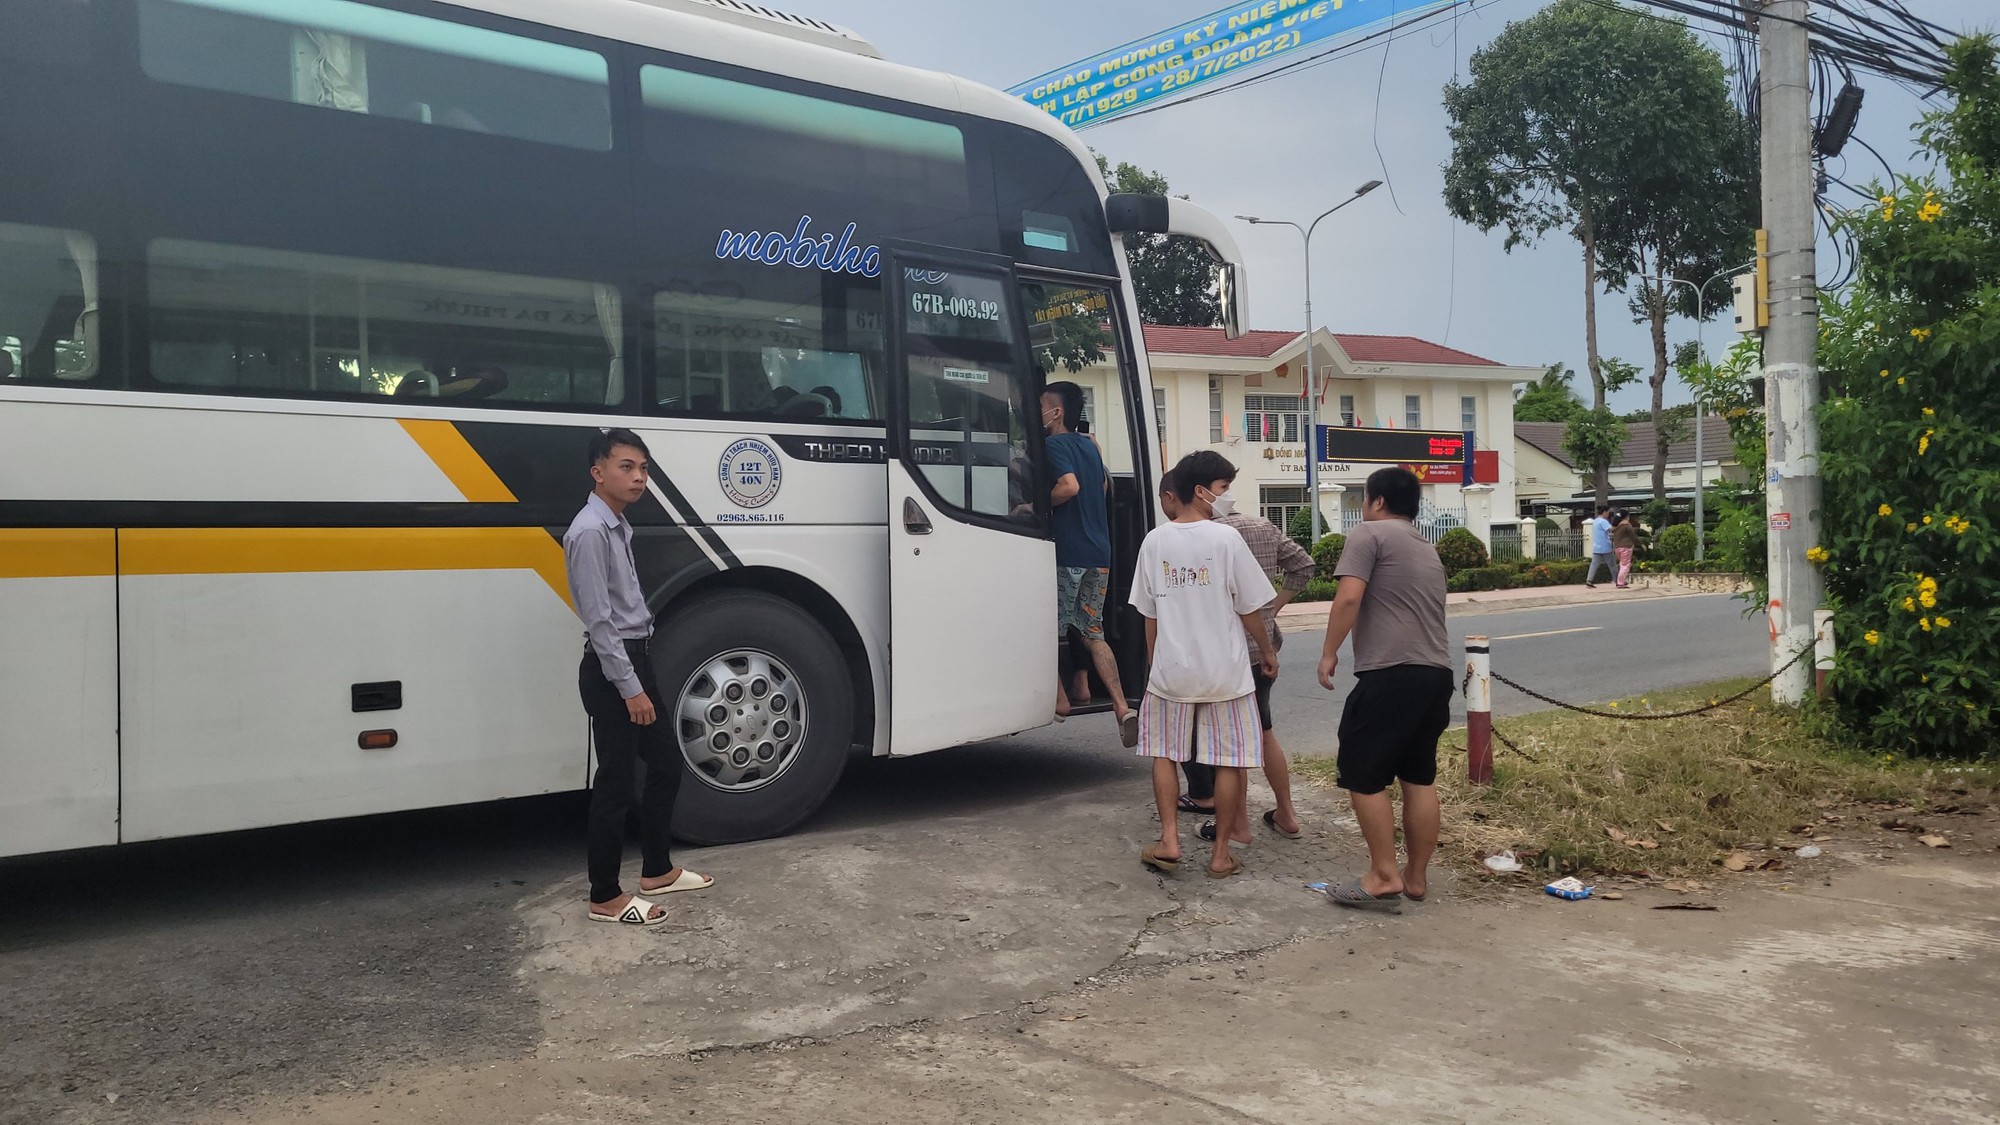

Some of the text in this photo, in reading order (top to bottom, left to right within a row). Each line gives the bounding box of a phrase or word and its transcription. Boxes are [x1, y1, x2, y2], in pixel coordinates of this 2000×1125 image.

[1032, 68, 1091, 99] CHÀO
[1099, 38, 1175, 75] MỪNG
[1063, 82, 1105, 107] LẬP
[1113, 54, 1183, 88] CÔNG
[1192, 23, 1272, 60] ĐOÀN
[1161, 30, 1301, 91] 28/7/2022)
[912, 292, 999, 321] 67B-003.92
[740, 462, 762, 471] 12T
[1317, 463, 1333, 472] HÂN
[1335, 463, 1351, 472] DÂN
[739, 476, 762, 485] 40N
[716, 513, 785, 522] 02963.865.116
